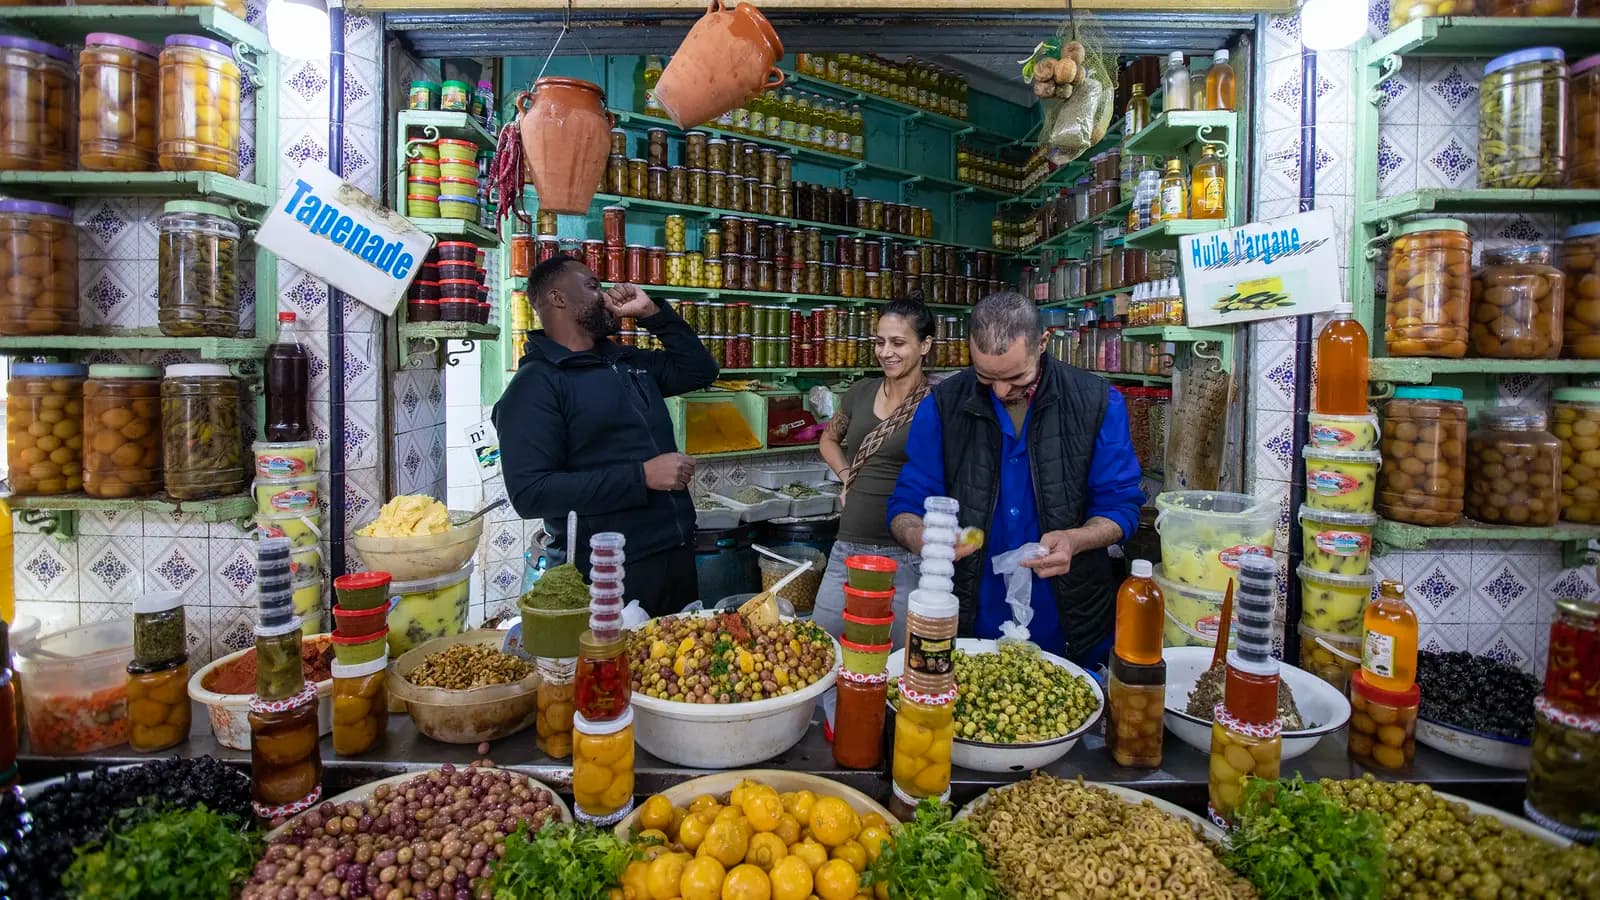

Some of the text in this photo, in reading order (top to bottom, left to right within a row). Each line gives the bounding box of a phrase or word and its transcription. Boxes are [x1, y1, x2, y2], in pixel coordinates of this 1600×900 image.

[284, 179, 413, 279] Tapenade
[1191, 227, 1300, 268] Huile d'argane
